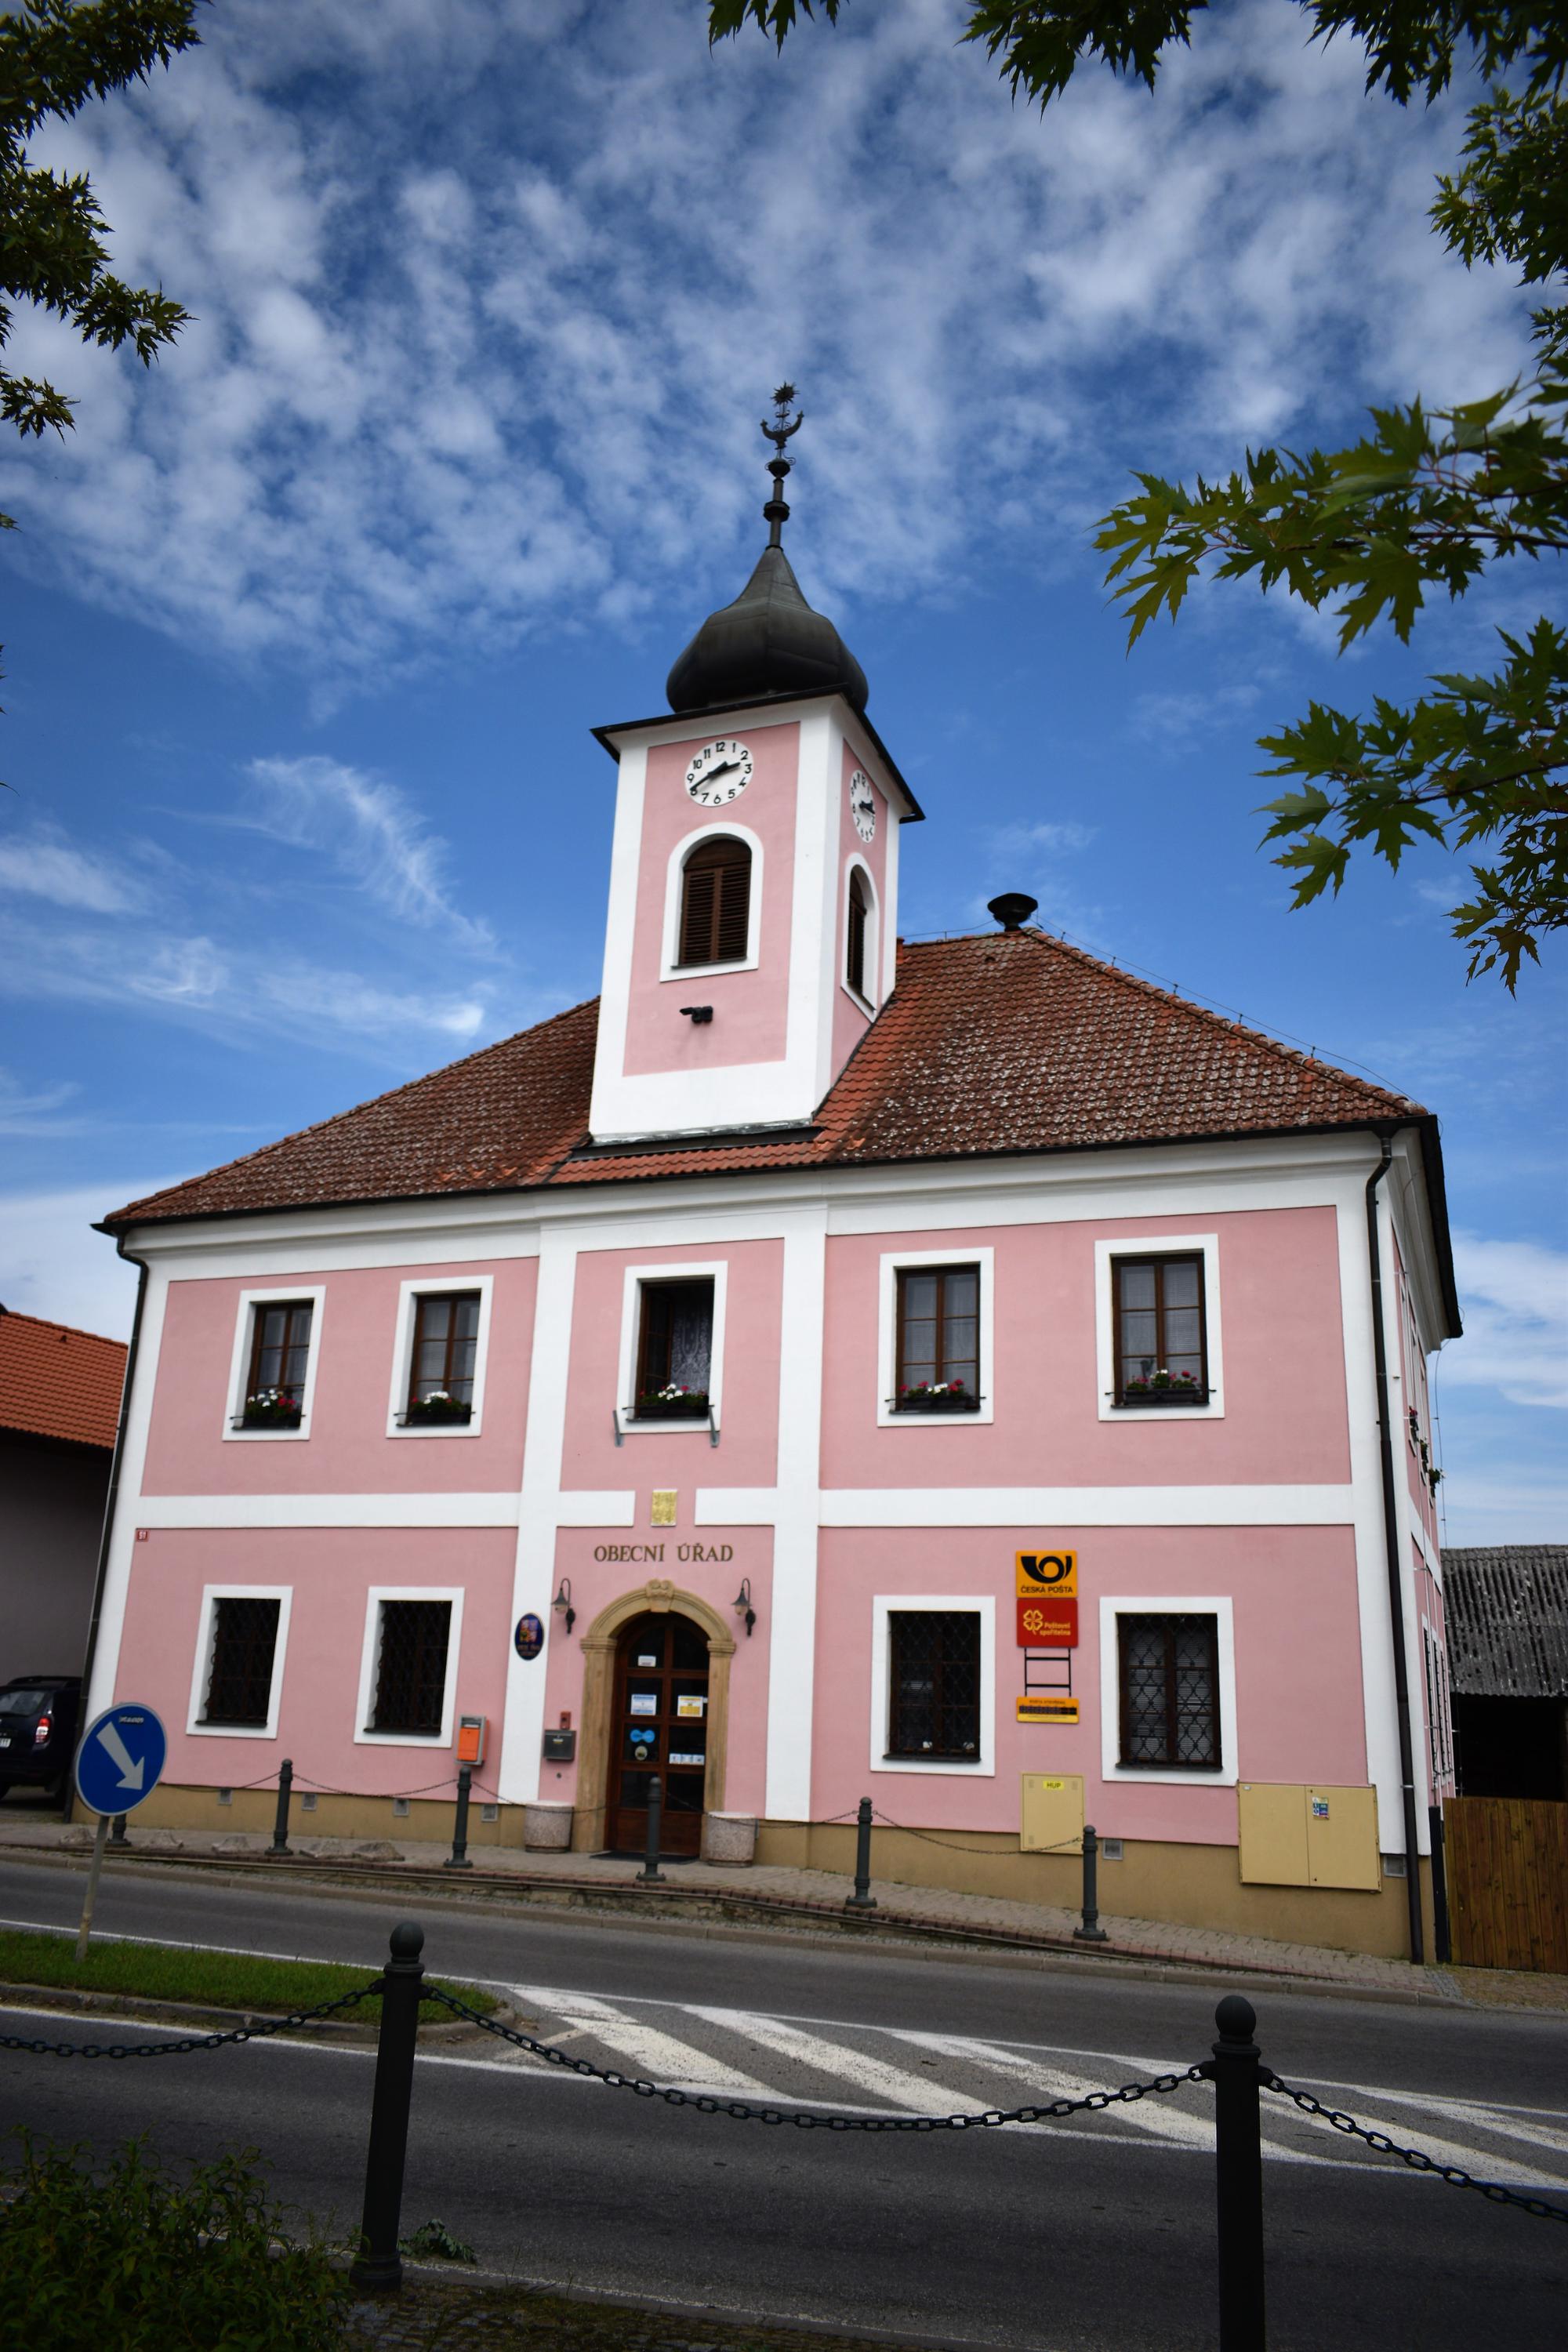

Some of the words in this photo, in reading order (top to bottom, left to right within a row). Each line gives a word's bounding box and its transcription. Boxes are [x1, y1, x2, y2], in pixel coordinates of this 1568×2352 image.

[716, 742, 725, 753] 12
[732, 742, 736, 753] 1
[704, 748, 711, 759] 11
[740, 750, 749, 760] 2
[693, 759, 702, 770] 10
[745, 763, 753, 774] 3
[687, 773, 695, 783] 9
[739, 777, 746, 787] 4
[701, 792, 710, 803] 7
[713, 794, 721, 804] 6
[728, 789, 735, 799] 5
[593, 1544, 665, 1563] OBECNÍ
[677, 1542, 734, 1563] ÚŘAD
[1021, 1584, 1046, 1593] ČESKÁ
[1047, 1584, 1073, 1593] POŠTA
